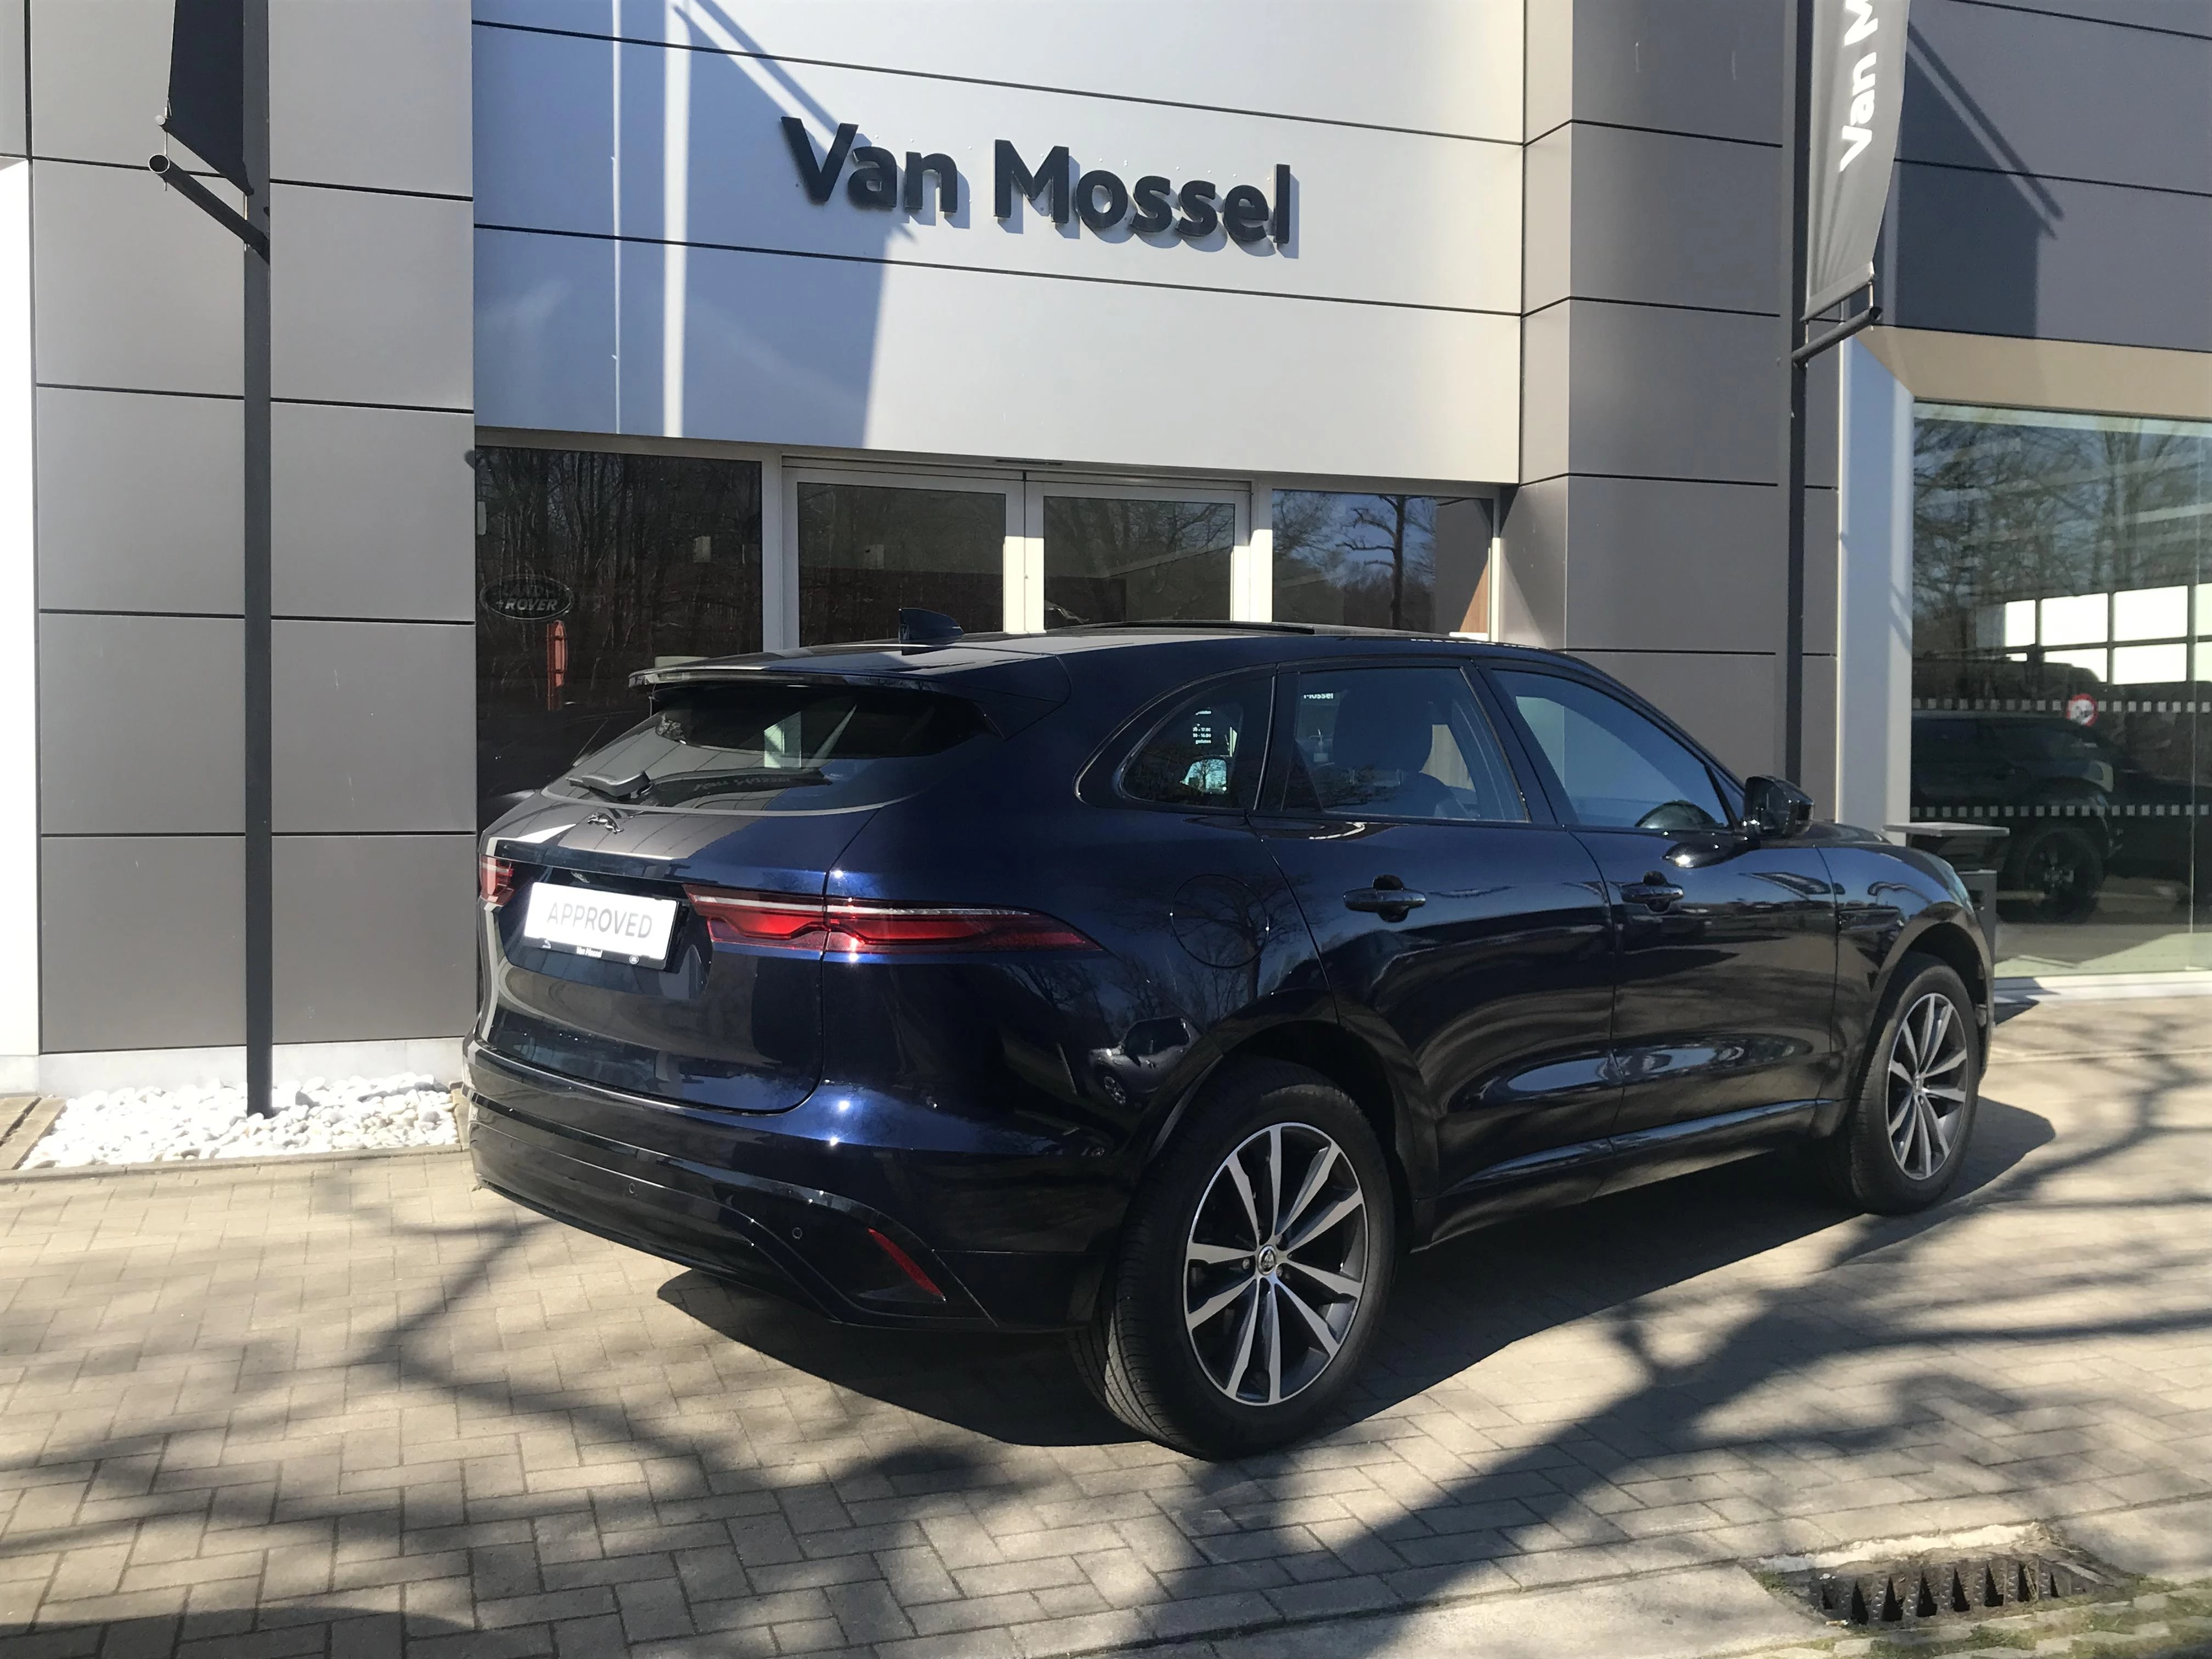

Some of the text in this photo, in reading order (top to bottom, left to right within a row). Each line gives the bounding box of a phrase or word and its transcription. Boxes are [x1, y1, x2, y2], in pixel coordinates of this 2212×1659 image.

[1839, 52, 1877, 172] Van
[781, 116, 1291, 245] Van Mossel
[504, 598, 558, 611] ROVER
[546, 902, 653, 939] APPROVED
